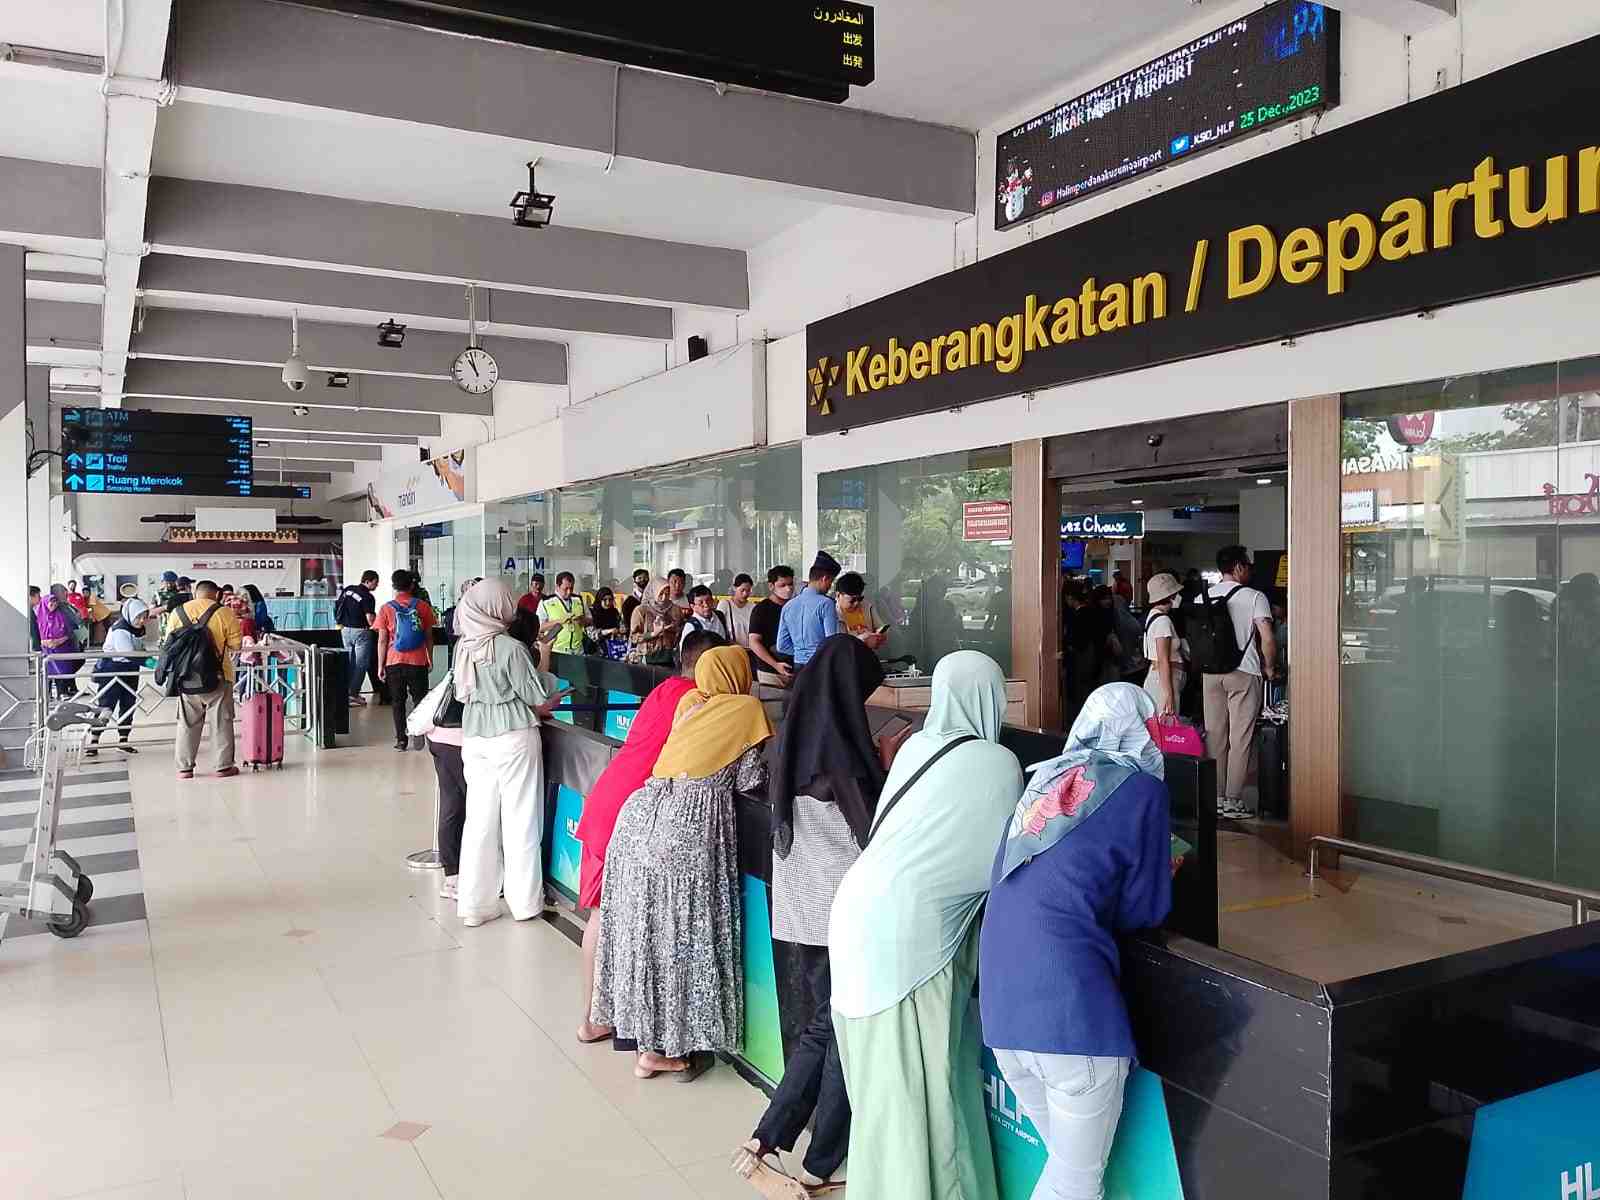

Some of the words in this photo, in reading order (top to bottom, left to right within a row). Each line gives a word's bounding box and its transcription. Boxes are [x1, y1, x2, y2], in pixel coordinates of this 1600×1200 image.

[813, 7, 864, 25] المغادرون
[1134, 56, 1195, 101] AIRPORT
[1239, 110, 1255, 129] 25
[845, 269, 1168, 398] Keberangkatan
[1184, 239, 1209, 312] /
[1226, 145, 1600, 296] Departur
[106, 474, 139, 486] Ruang
[141, 475, 183, 486] Merokok
